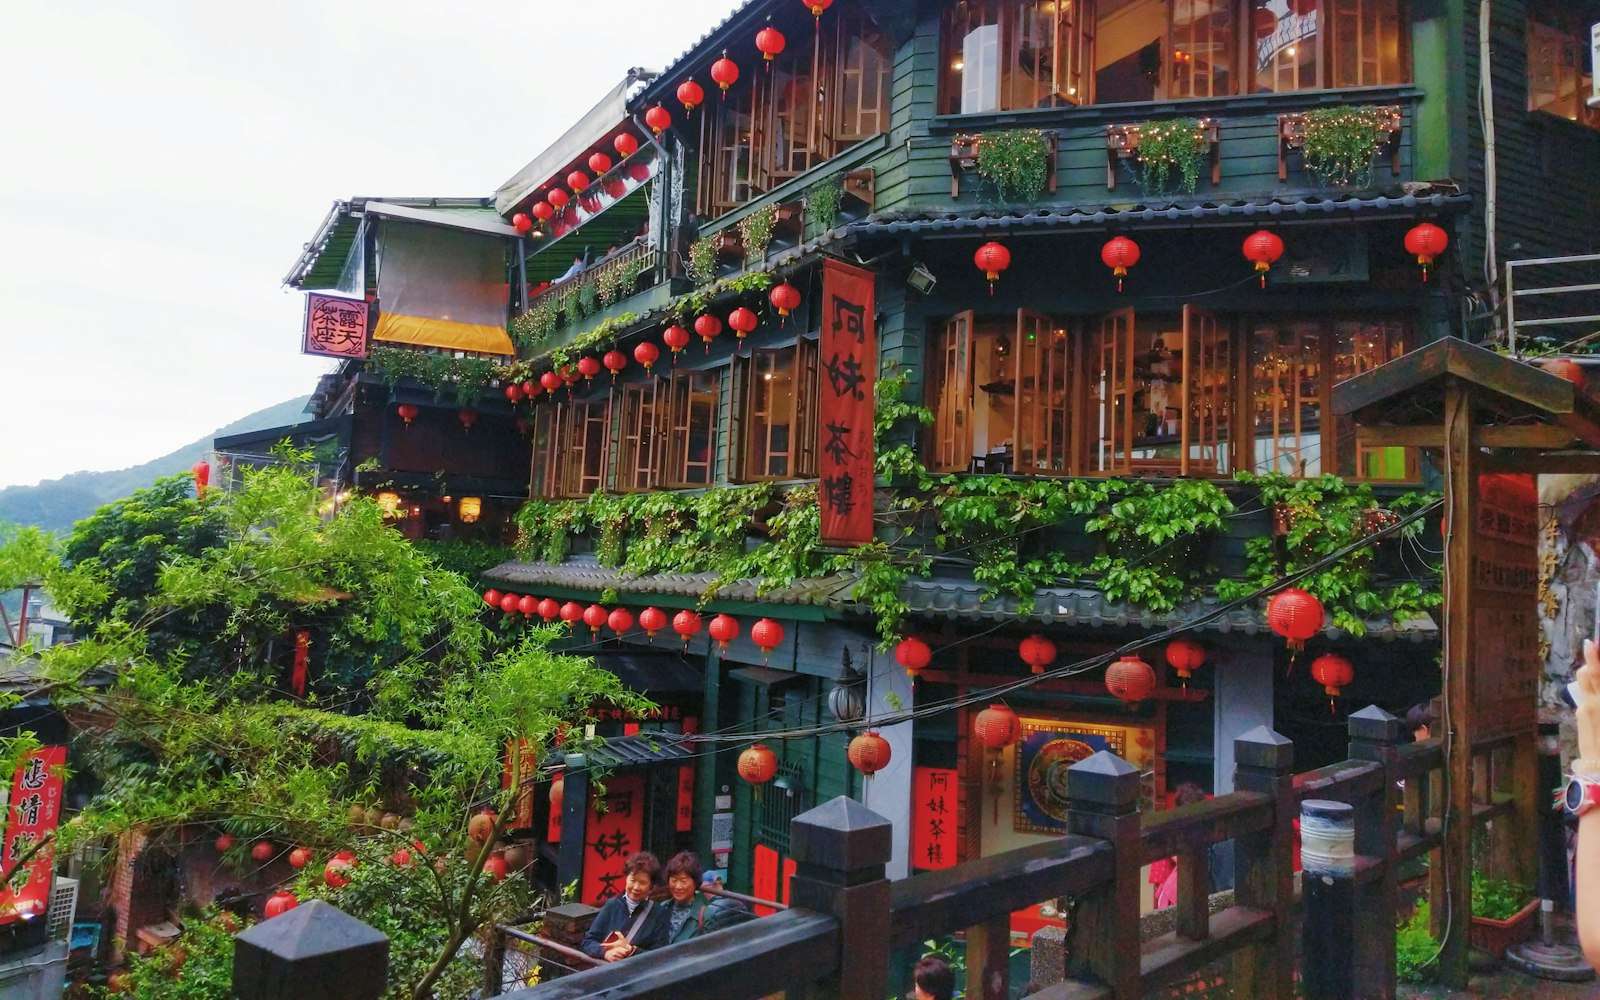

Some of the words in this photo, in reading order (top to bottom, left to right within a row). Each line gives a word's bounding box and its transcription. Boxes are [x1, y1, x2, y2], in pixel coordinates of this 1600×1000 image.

[337, 308, 364, 347] 露天
[822, 294, 866, 516] 阿妹茶樓
